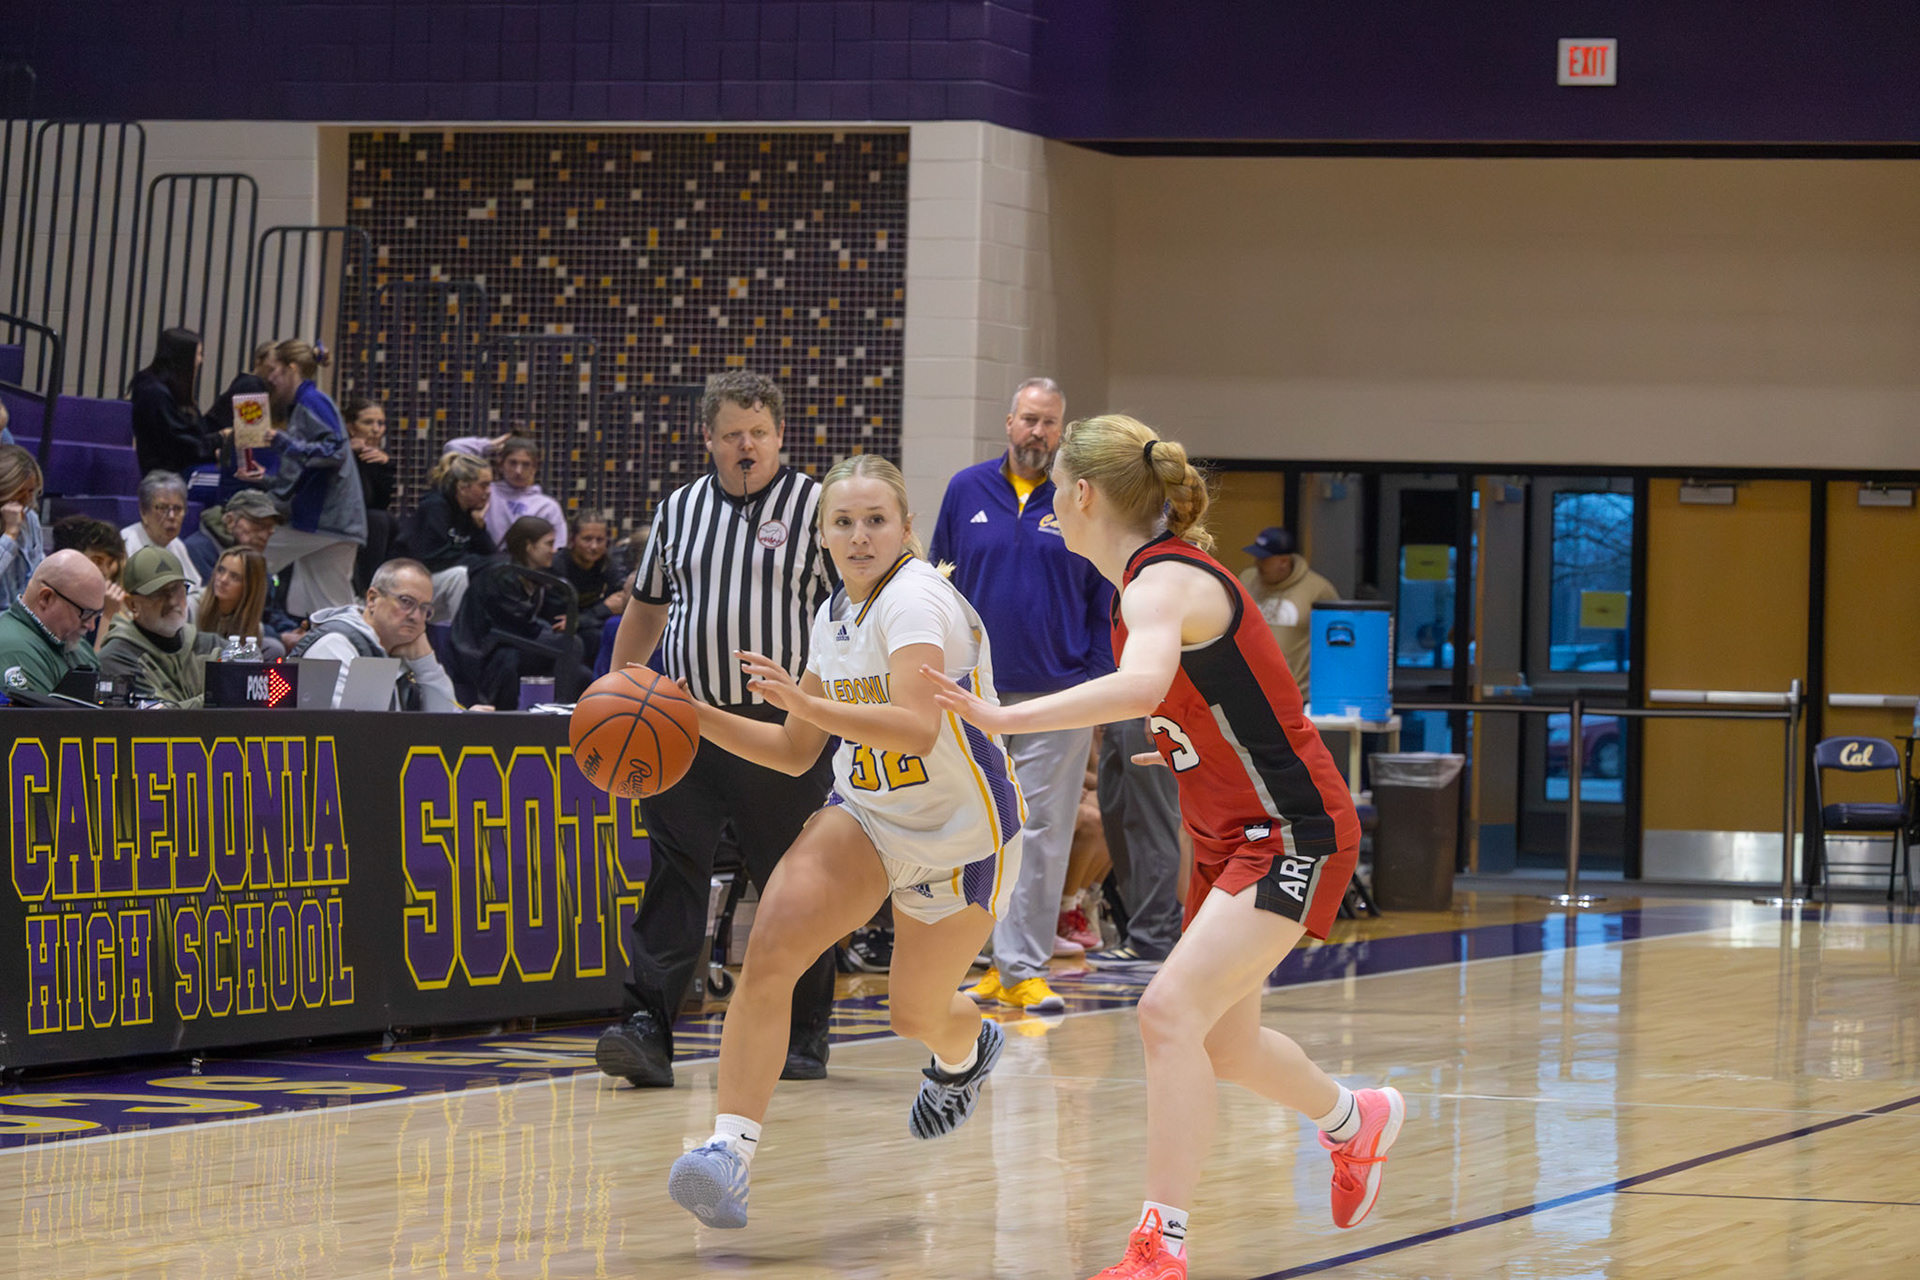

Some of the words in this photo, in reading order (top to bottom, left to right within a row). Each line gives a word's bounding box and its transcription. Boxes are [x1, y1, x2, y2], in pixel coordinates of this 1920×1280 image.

[1569, 46, 1609, 77] EXIT
[1840, 742, 1874, 766] Cal
[9, 736, 349, 901] CALEDONIA
[26, 914, 153, 1034] HIGH
[174, 898, 354, 1020] SCHOOL
